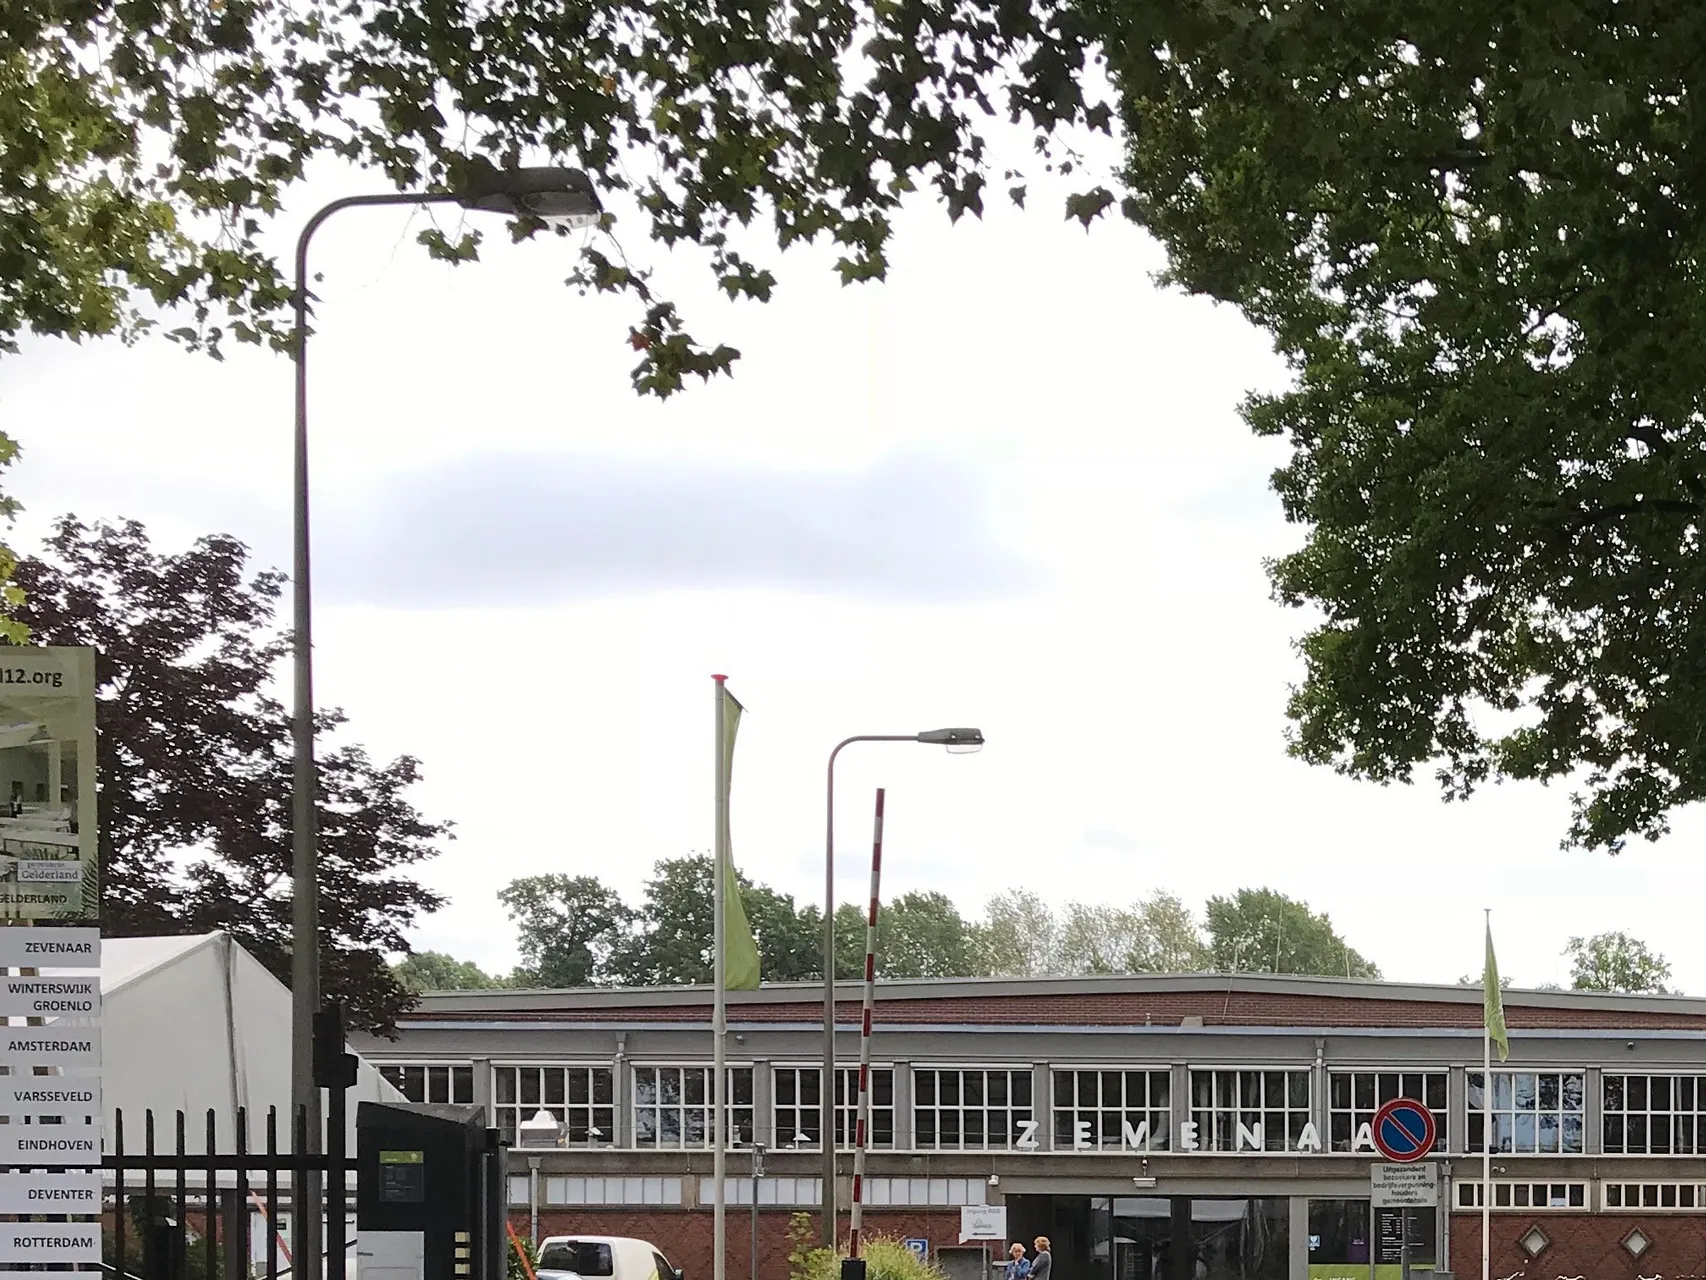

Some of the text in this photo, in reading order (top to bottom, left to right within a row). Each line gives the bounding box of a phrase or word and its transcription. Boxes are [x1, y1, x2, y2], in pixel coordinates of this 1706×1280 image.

[21, 870, 79, 879] Gelderland
[25, 942, 92, 953] ZEVENAAR
[8, 983, 92, 994] WINTERSWIJK
[33, 1001, 92, 1011] GROENLO
[8, 1041, 91, 1052] AMSTERDAM
[14, 1091, 93, 1102] VARSSEVELD
[1016, 1120, 1375, 1151] ZEVENAA
[18, 1139, 93, 1150] EINDHOVEN
[28, 1189, 93, 1200] DEVENTER
[13, 1237, 93, 1248] ROTTERDAM
